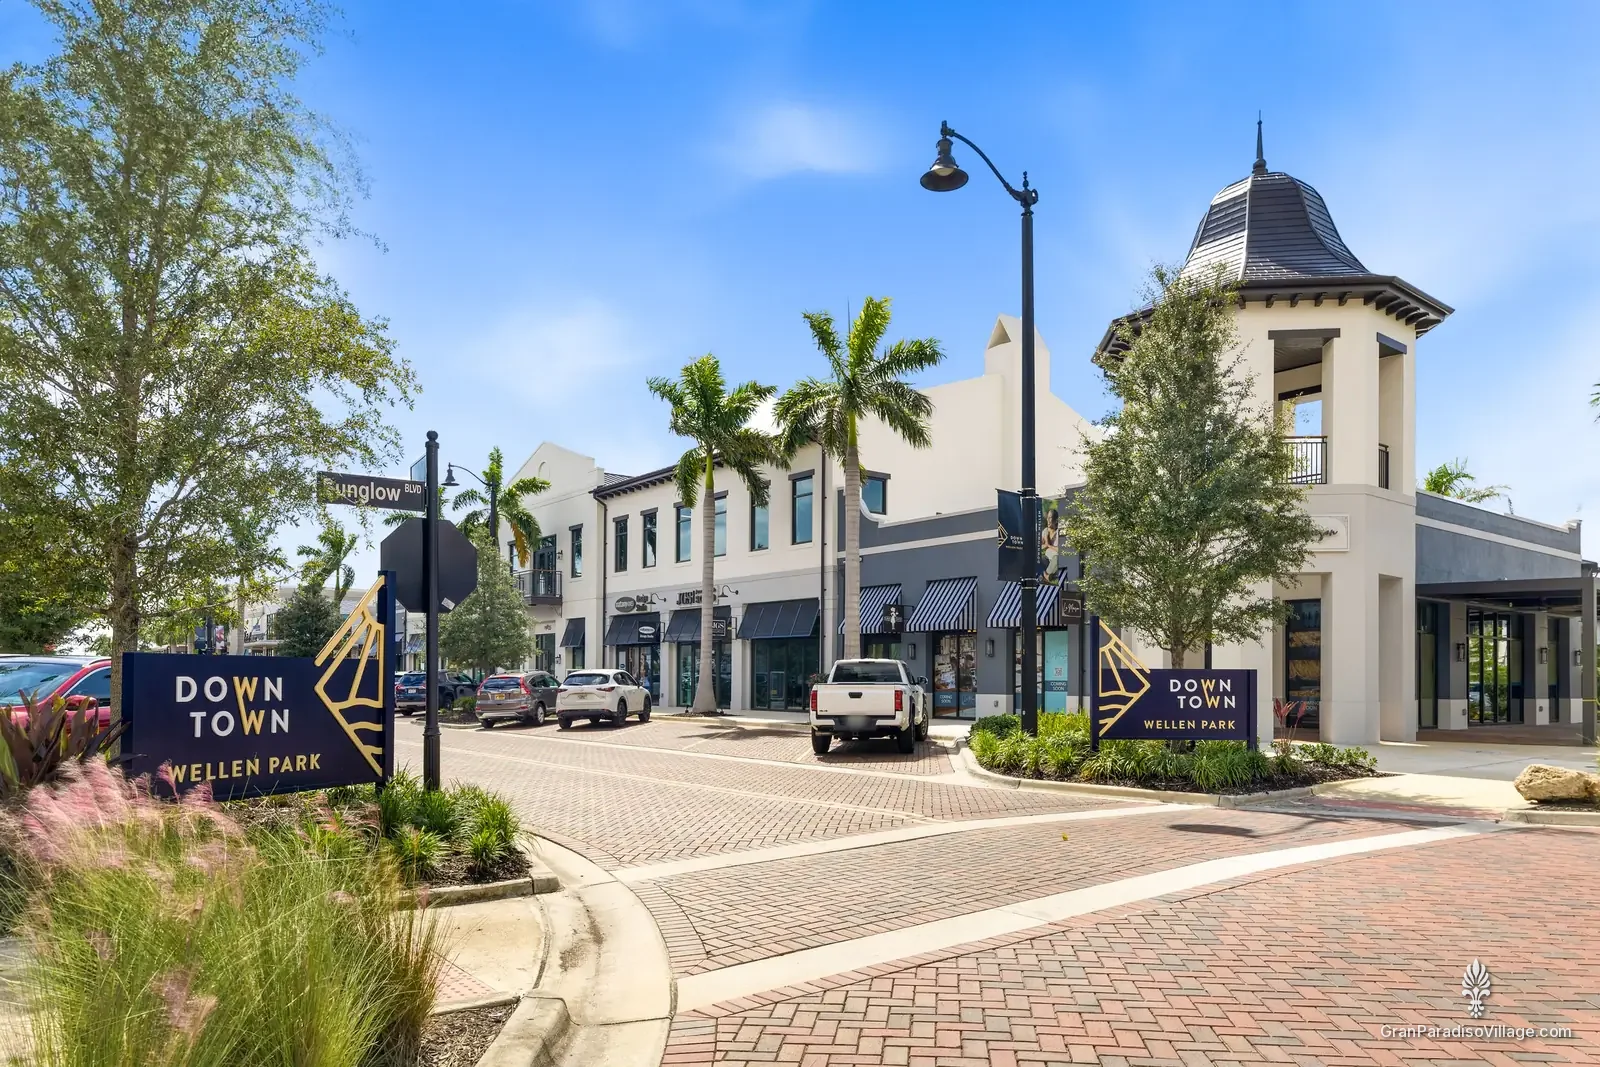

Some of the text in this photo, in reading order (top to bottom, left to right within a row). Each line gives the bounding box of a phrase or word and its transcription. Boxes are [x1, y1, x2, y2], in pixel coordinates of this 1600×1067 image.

[404, 483, 422, 494] BLVD
[175, 675, 284, 703] DOWN
[1169, 679, 1231, 692] DOWN
[1177, 695, 1236, 709] TOWN
[189, 708, 290, 739] TOWN
[1144, 720, 1236, 730] WELLEN PARK
[168, 753, 321, 784] WELLEN PARK
